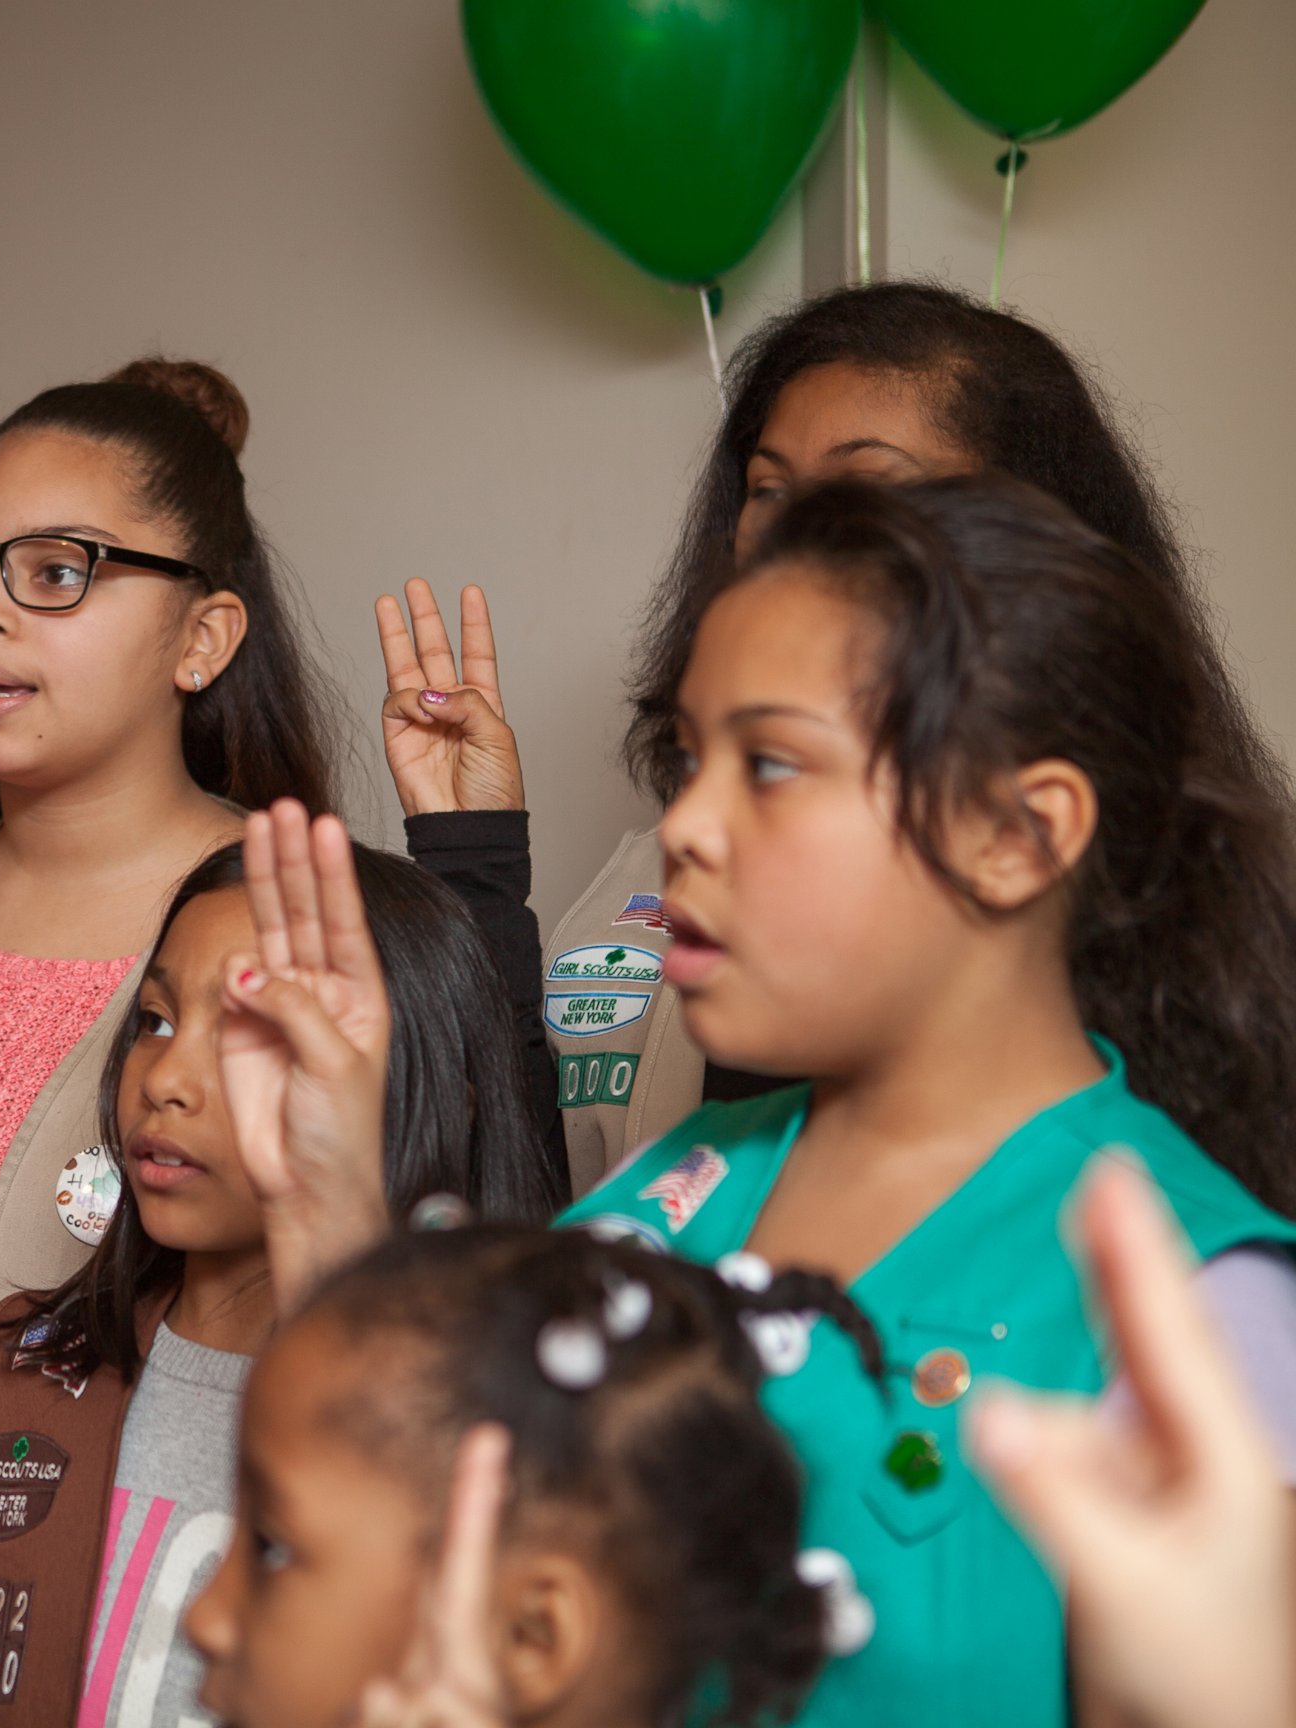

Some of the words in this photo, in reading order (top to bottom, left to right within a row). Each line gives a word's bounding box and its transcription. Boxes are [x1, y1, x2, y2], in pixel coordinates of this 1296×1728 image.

[554, 963, 580, 975] GIRL
[581, 964, 633, 976] SCOUTS
[633, 967, 661, 978] USA
[568, 999, 617, 1012] GREATER
[560, 1012, 585, 1026] NEW
[586, 1012, 617, 1024] YORK
[37, 1462, 62, 1480] USA
[1, 1510, 28, 1527] YORK
